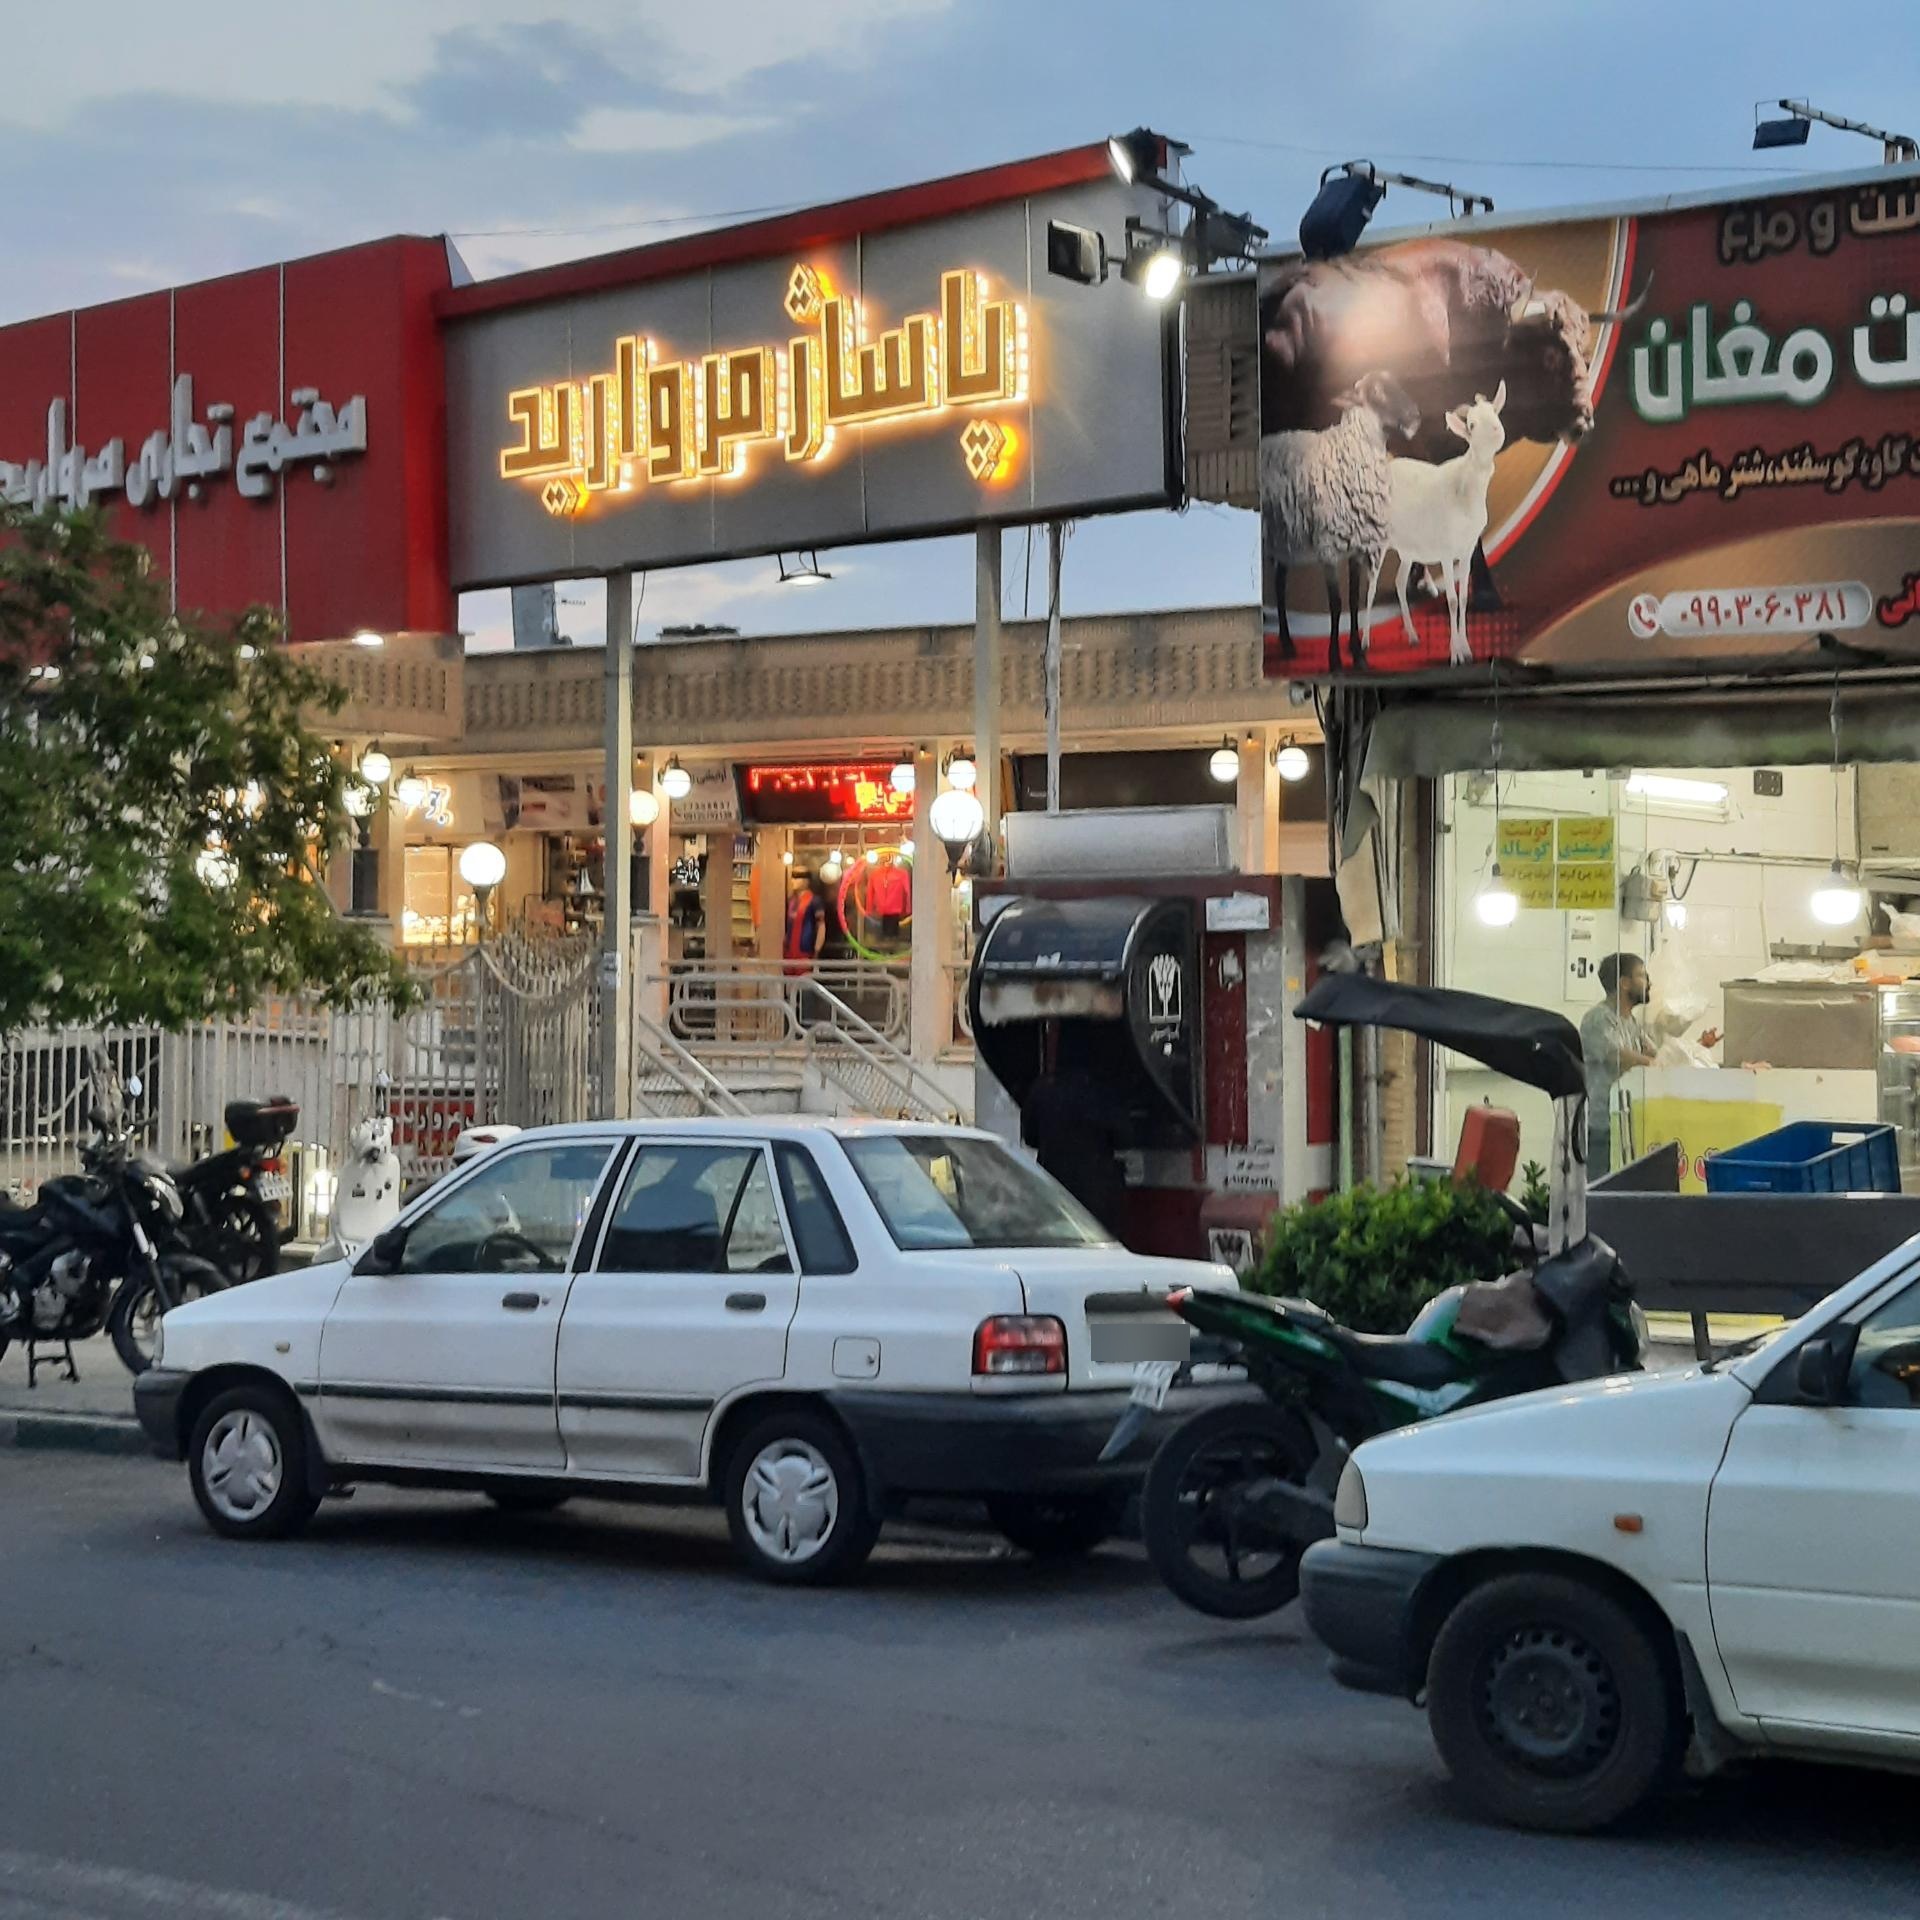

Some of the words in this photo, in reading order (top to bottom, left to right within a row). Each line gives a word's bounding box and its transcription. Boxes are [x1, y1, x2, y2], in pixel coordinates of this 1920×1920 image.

[1810, 202, 1835, 250] و
[1634, 300, 1832, 420] مغان
[236, 386, 367, 499] مجتمع
[500, 332, 782, 516] مروارید
[1680, 587, 1847, 627] ۰۹۹۰۳۰۶۰۳۸۱
